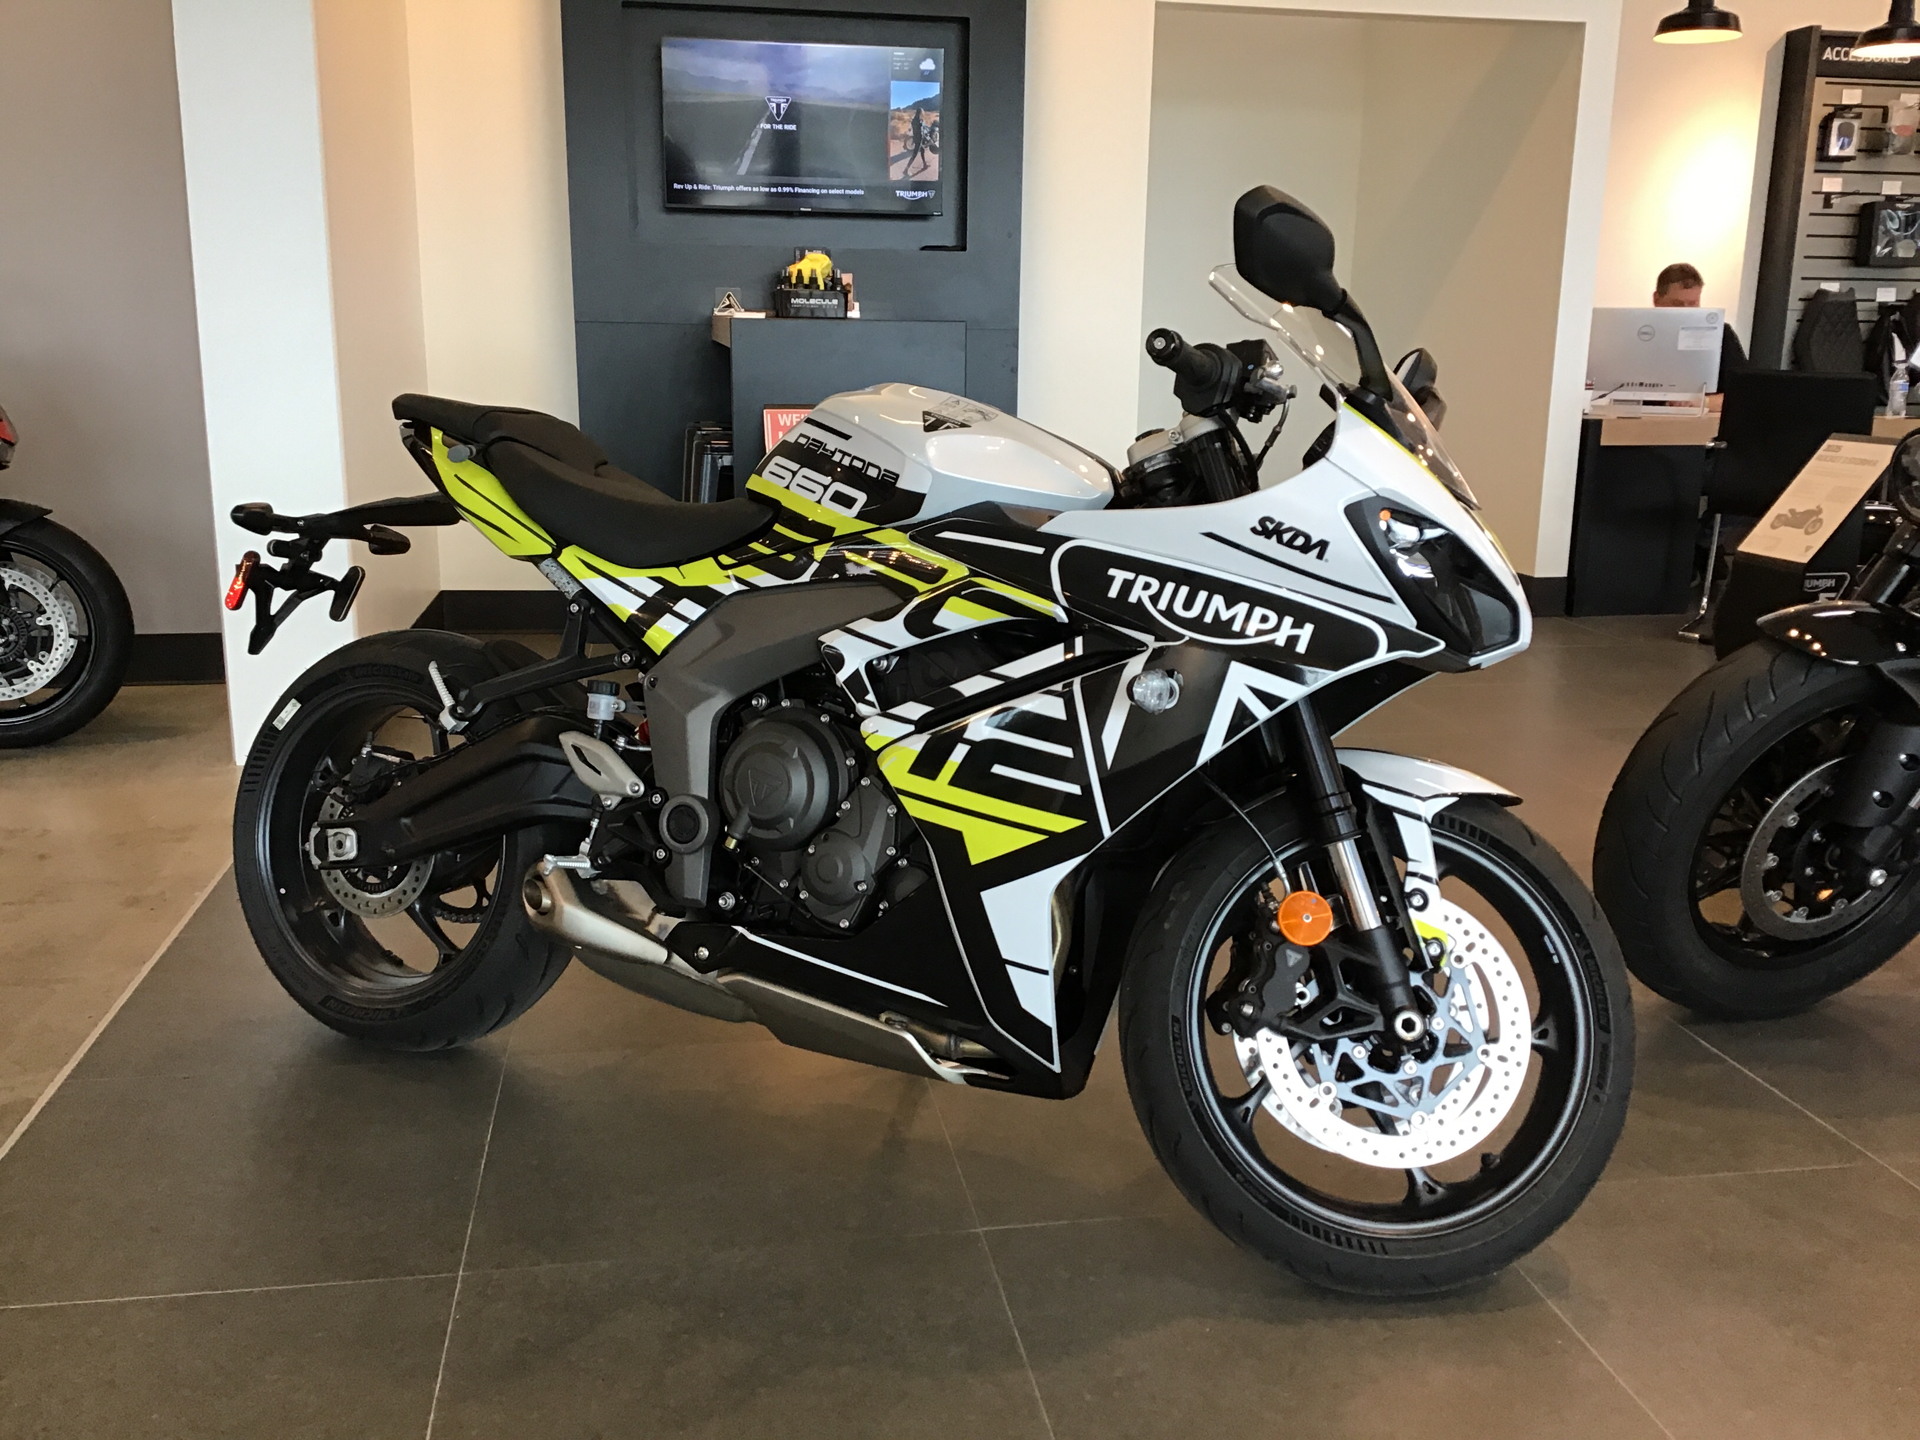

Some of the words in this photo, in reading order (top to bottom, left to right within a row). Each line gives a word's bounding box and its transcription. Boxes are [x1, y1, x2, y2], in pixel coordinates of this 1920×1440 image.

[698, 183, 712, 191] Ride:
[713, 184, 735, 192] Triumph
[794, 186, 820, 195] Financing
[828, 187, 844, 195] select
[895, 190, 928, 200] TRIUMPH
[790, 297, 839, 305] MOLECULE
[761, 455, 868, 519] 660
[1249, 515, 1331, 561] SKDA
[1105, 567, 1316, 655] TRIUMPH
